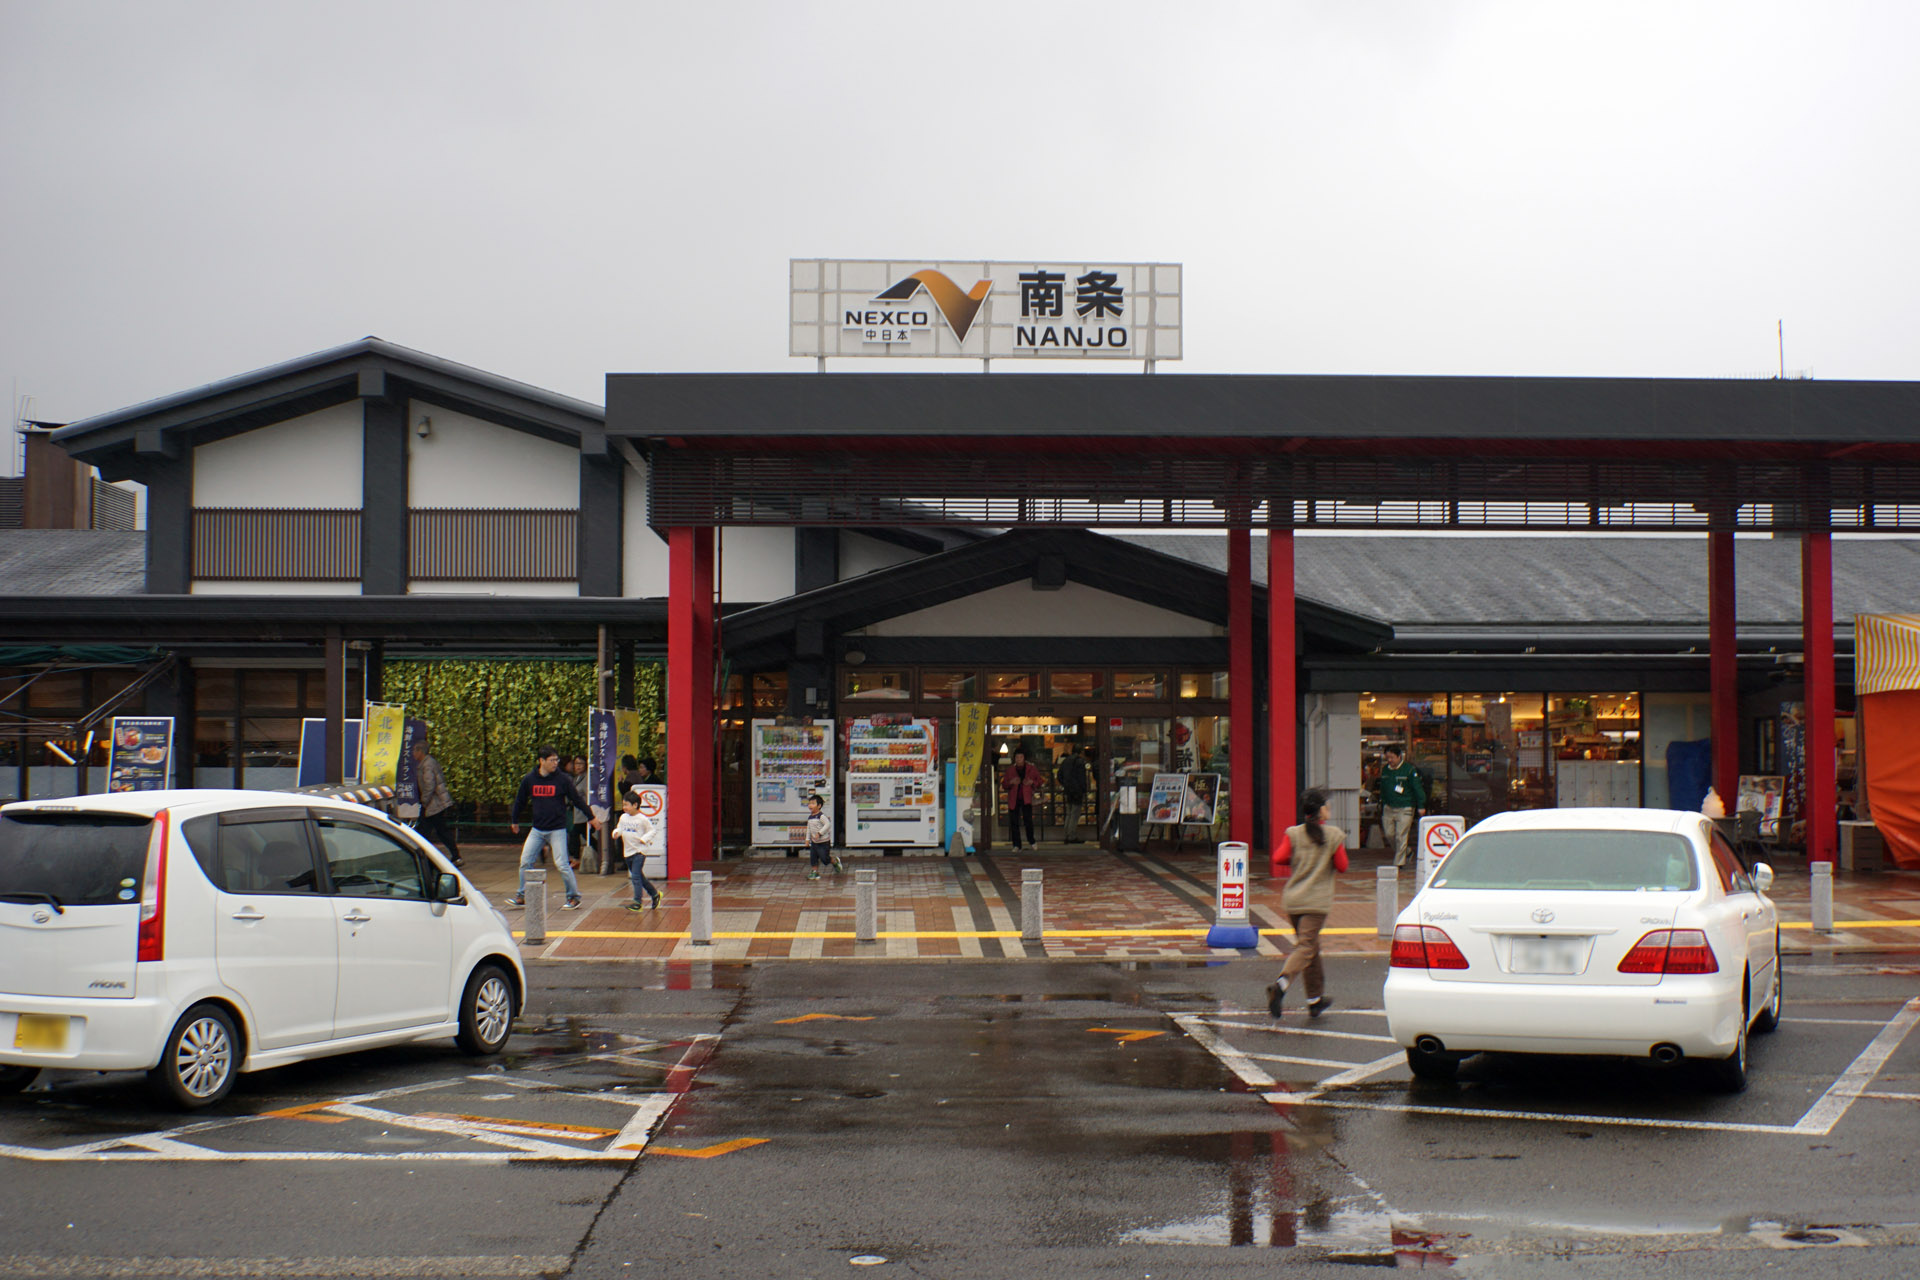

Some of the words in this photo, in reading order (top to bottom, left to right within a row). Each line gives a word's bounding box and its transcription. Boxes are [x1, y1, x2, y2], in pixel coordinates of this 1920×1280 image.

[1019, 270, 1124, 317] 南条
[845, 311, 928, 325] NEXCO
[865, 329, 908, 340] 中日本
[1017, 326, 1127, 347] NANJO
[962, 707, 979, 777] 北陸みやげ
[599, 722, 608, 782] 海鮮レストラン
[1640, 917, 1673, 925] CROWN
[88, 980, 127, 989] MOVE
